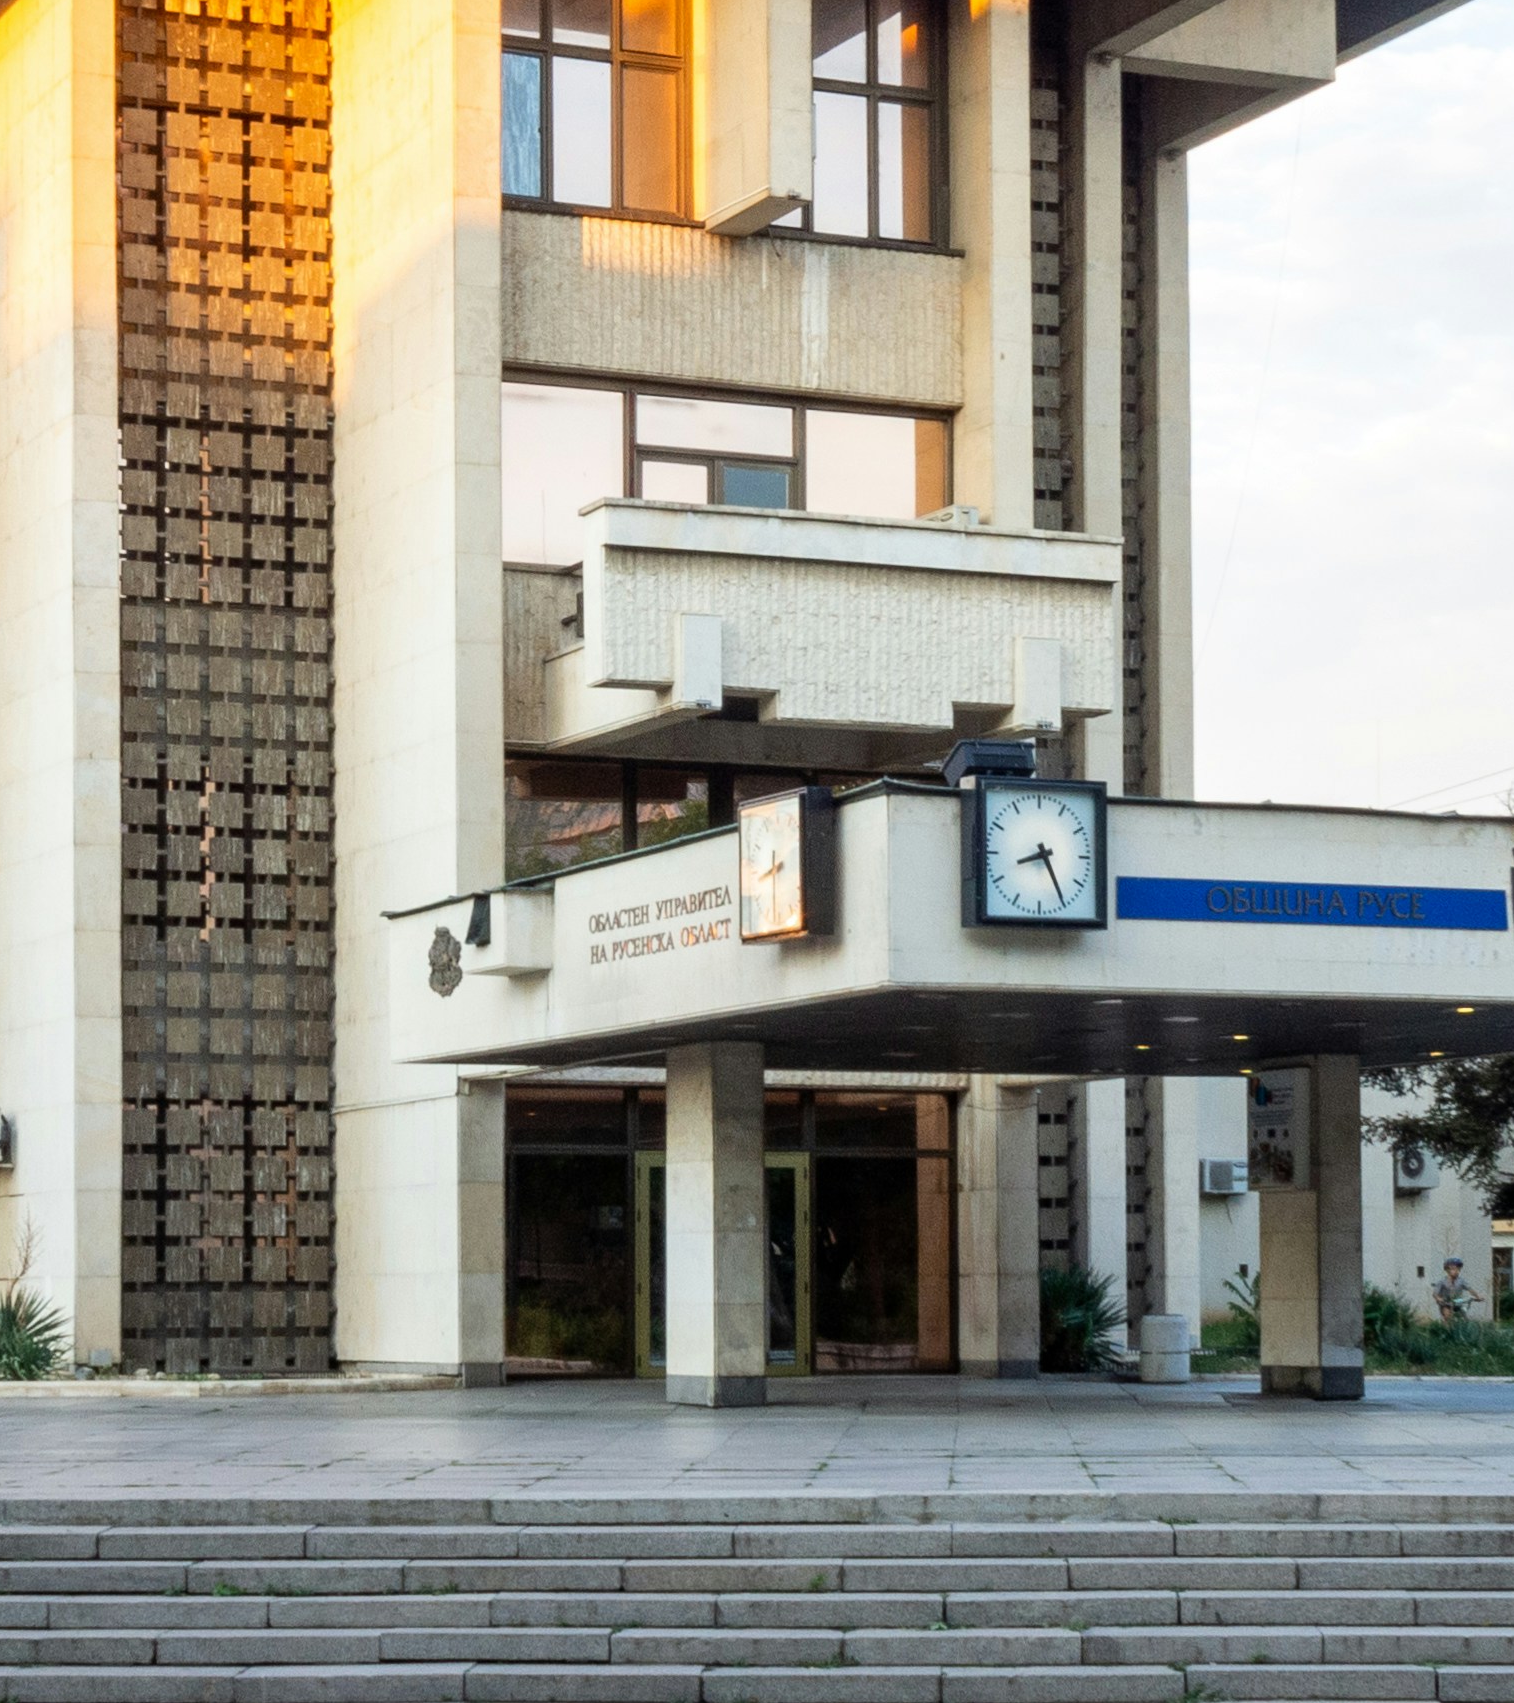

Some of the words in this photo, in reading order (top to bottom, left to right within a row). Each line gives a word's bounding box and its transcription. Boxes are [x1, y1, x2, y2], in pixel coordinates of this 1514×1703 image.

[589, 904, 650, 934] ОБЛАСТЕН
[655, 885, 732, 920] УПРАВИТЕЛ
[1357, 890, 1426, 920] РУСЕ
[590, 941, 608, 965] НА
[612, 931, 675, 961] РУСЕНСКА
[680, 918, 731, 948] ОБЛАСТ
